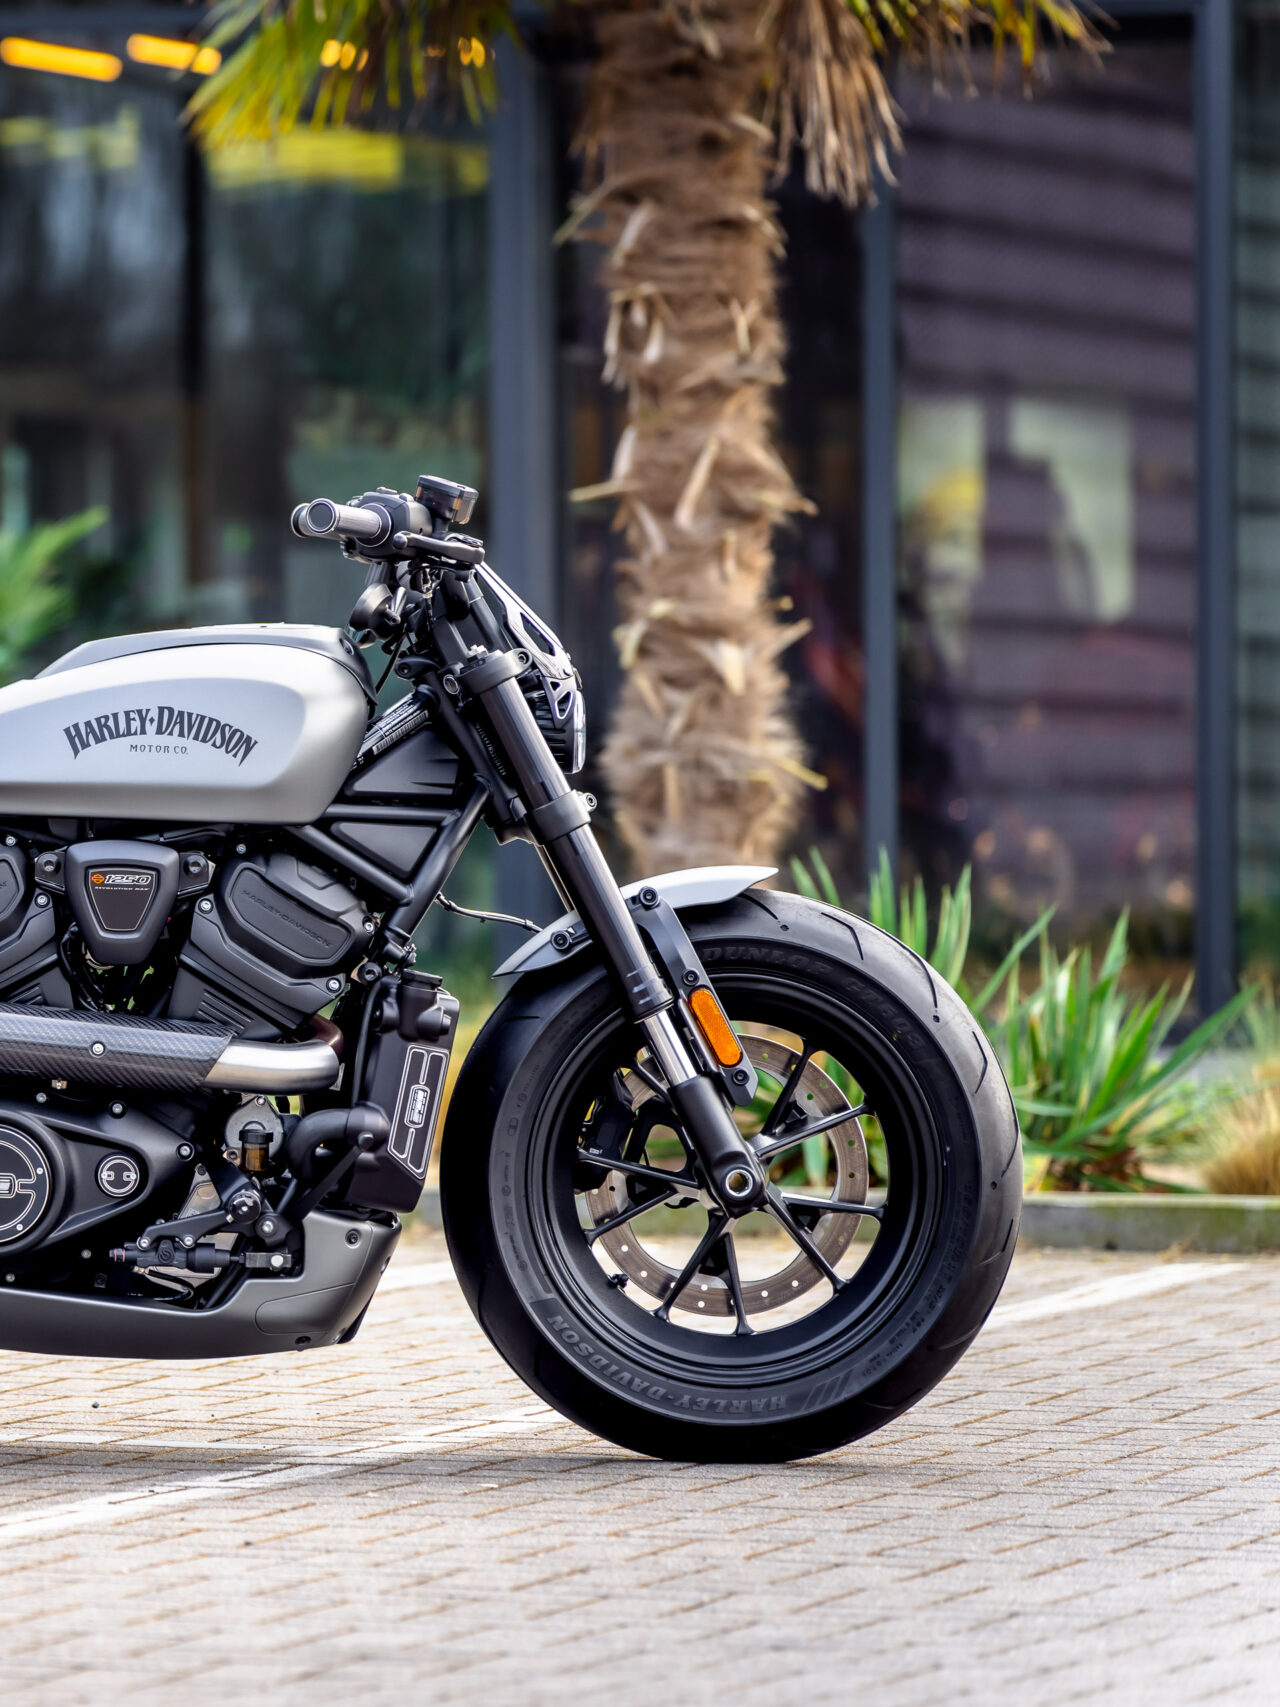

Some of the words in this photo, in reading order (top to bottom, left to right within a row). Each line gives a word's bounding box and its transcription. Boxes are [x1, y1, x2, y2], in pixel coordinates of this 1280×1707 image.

[130, 744, 170, 754] MOTOR
[173, 745, 189, 755] CO.
[104, 874, 152, 885] 1250
[701, 945, 834, 975] DUNLOP
[547, 1313, 788, 1415] HARLEY-DAVIDSON
